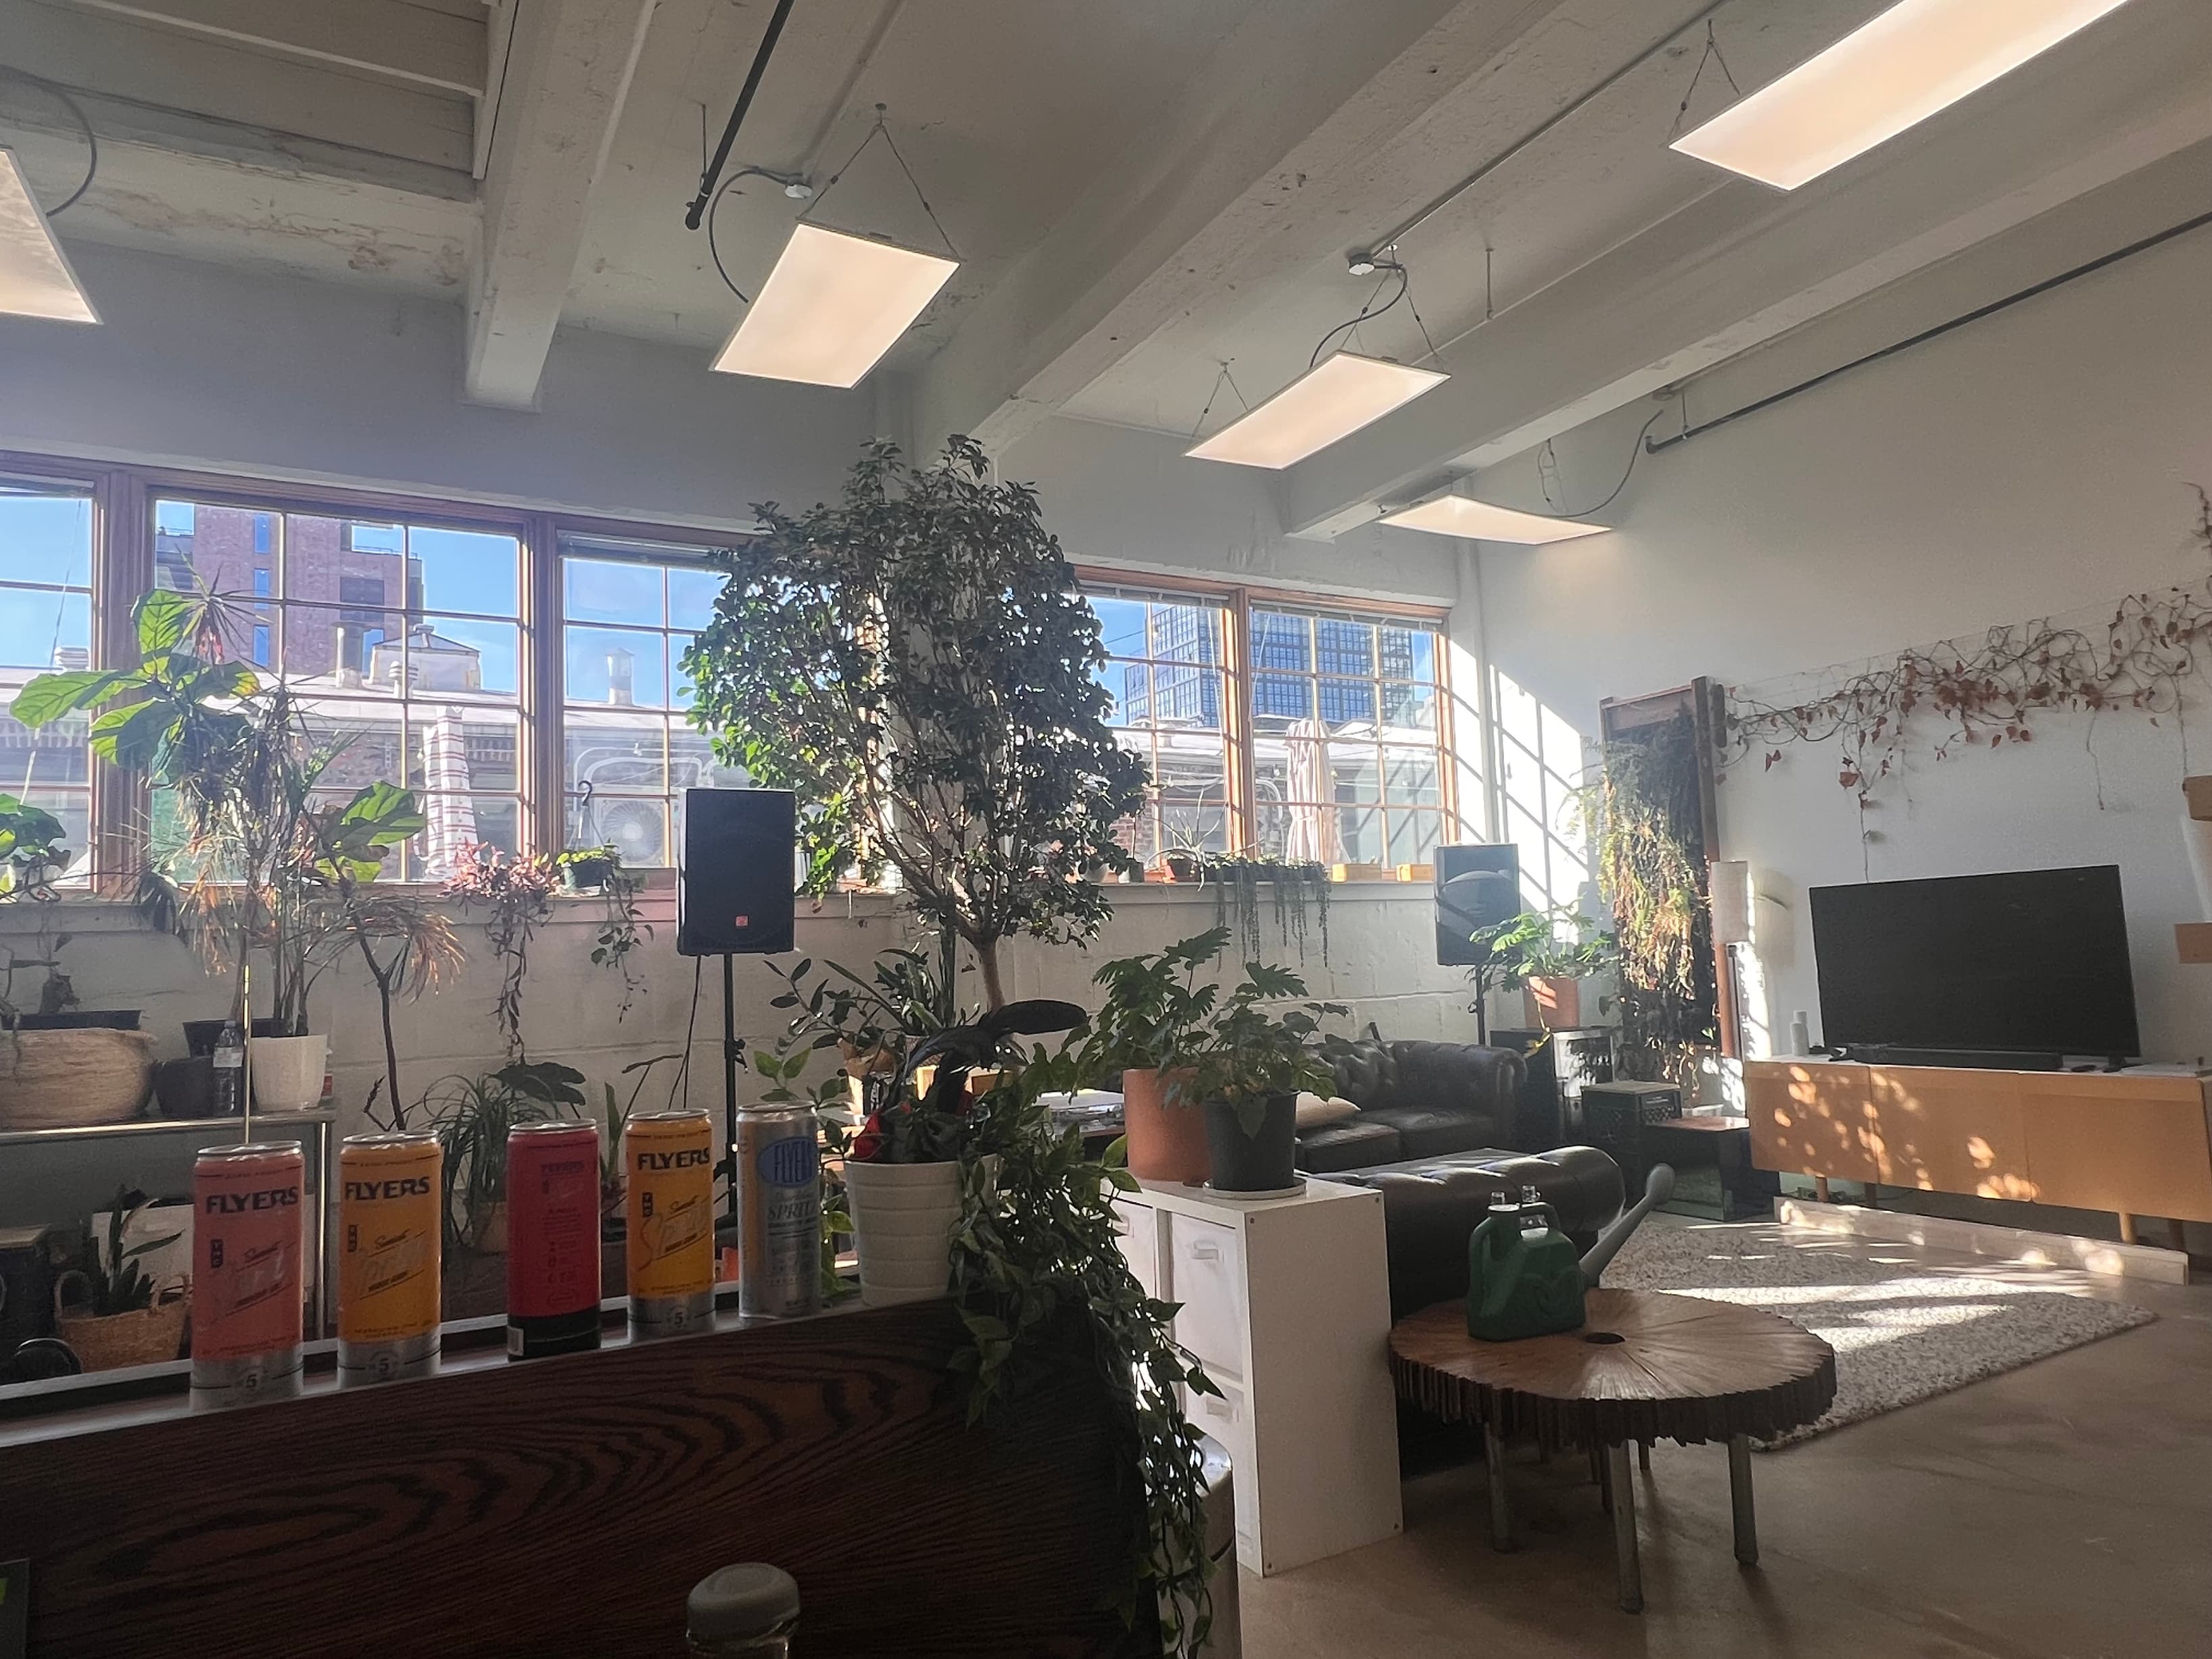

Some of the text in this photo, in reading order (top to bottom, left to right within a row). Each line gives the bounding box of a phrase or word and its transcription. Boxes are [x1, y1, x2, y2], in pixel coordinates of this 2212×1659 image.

[638, 1147, 710, 1170] FLYERS
[343, 1176, 431, 1201] FLYERS
[206, 1186, 299, 1214] FLYERS
[674, 1312, 683, 1325] 5
[379, 1357, 389, 1372] 5
[245, 1374, 258, 1388] 5
